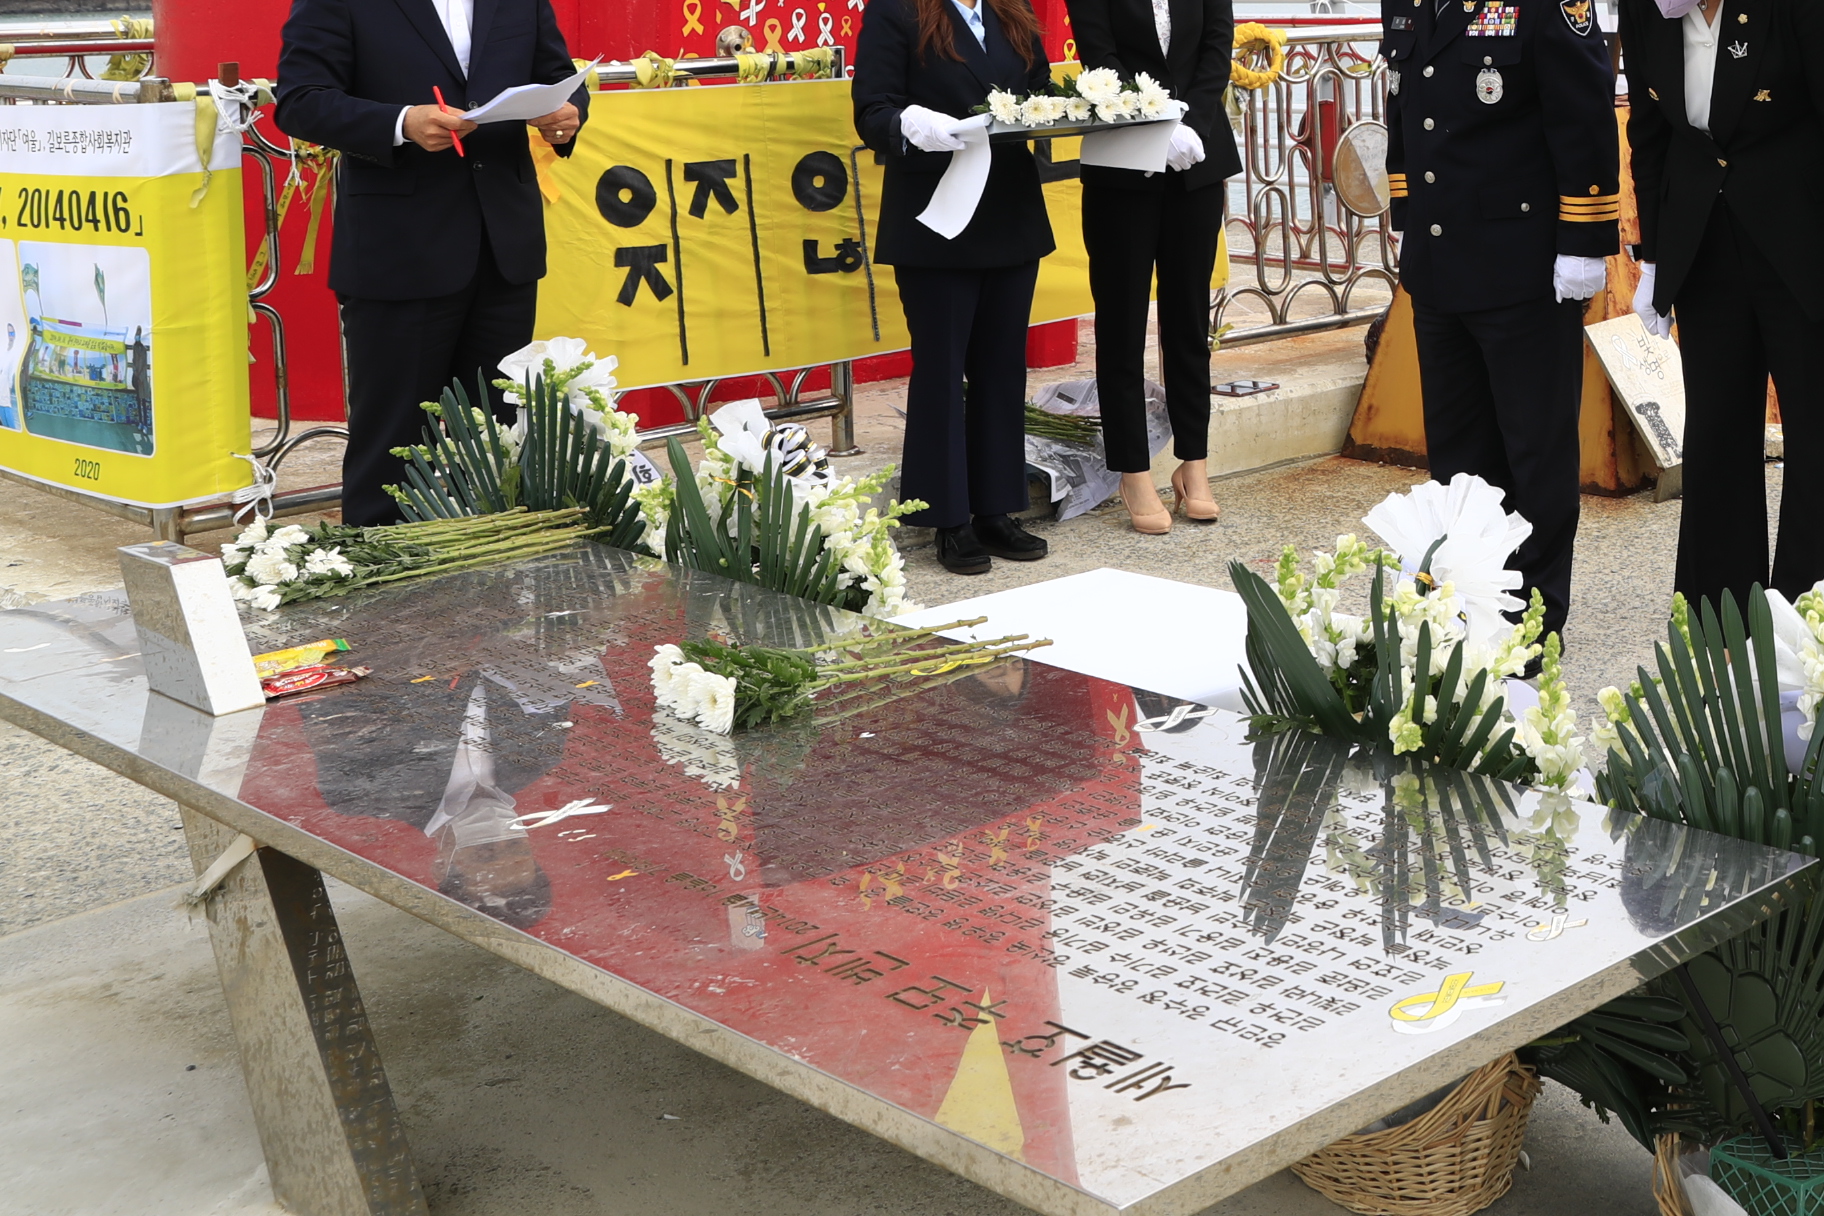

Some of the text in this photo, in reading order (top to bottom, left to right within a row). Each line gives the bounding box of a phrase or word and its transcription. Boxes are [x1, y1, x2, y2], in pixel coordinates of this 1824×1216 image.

[595, 153, 770, 366] 잊지
[74, 458, 101, 481] 2020
[1107, 901, 1177, 927] 김유민
[1269, 933, 1346, 960] 나강민
[1310, 919, 1386, 946] 박정은
[1404, 926, 1482, 955] 성민재
[1072, 914, 1360, 1015] 김빛나라 김상호 김선우 김성빈
[1109, 952, 1178, 979] 김기수
[1347, 956, 1425, 985] 김호연
[1173, 974, 1254, 1005] 김건호
[781, 933, 1188, 1100] 세월호 추모 벤치
[1136, 989, 1210, 1020] 강수정
[1249, 1002, 1325, 1031] 김건우
[1209, 1016, 1286, 1048] 강민규
